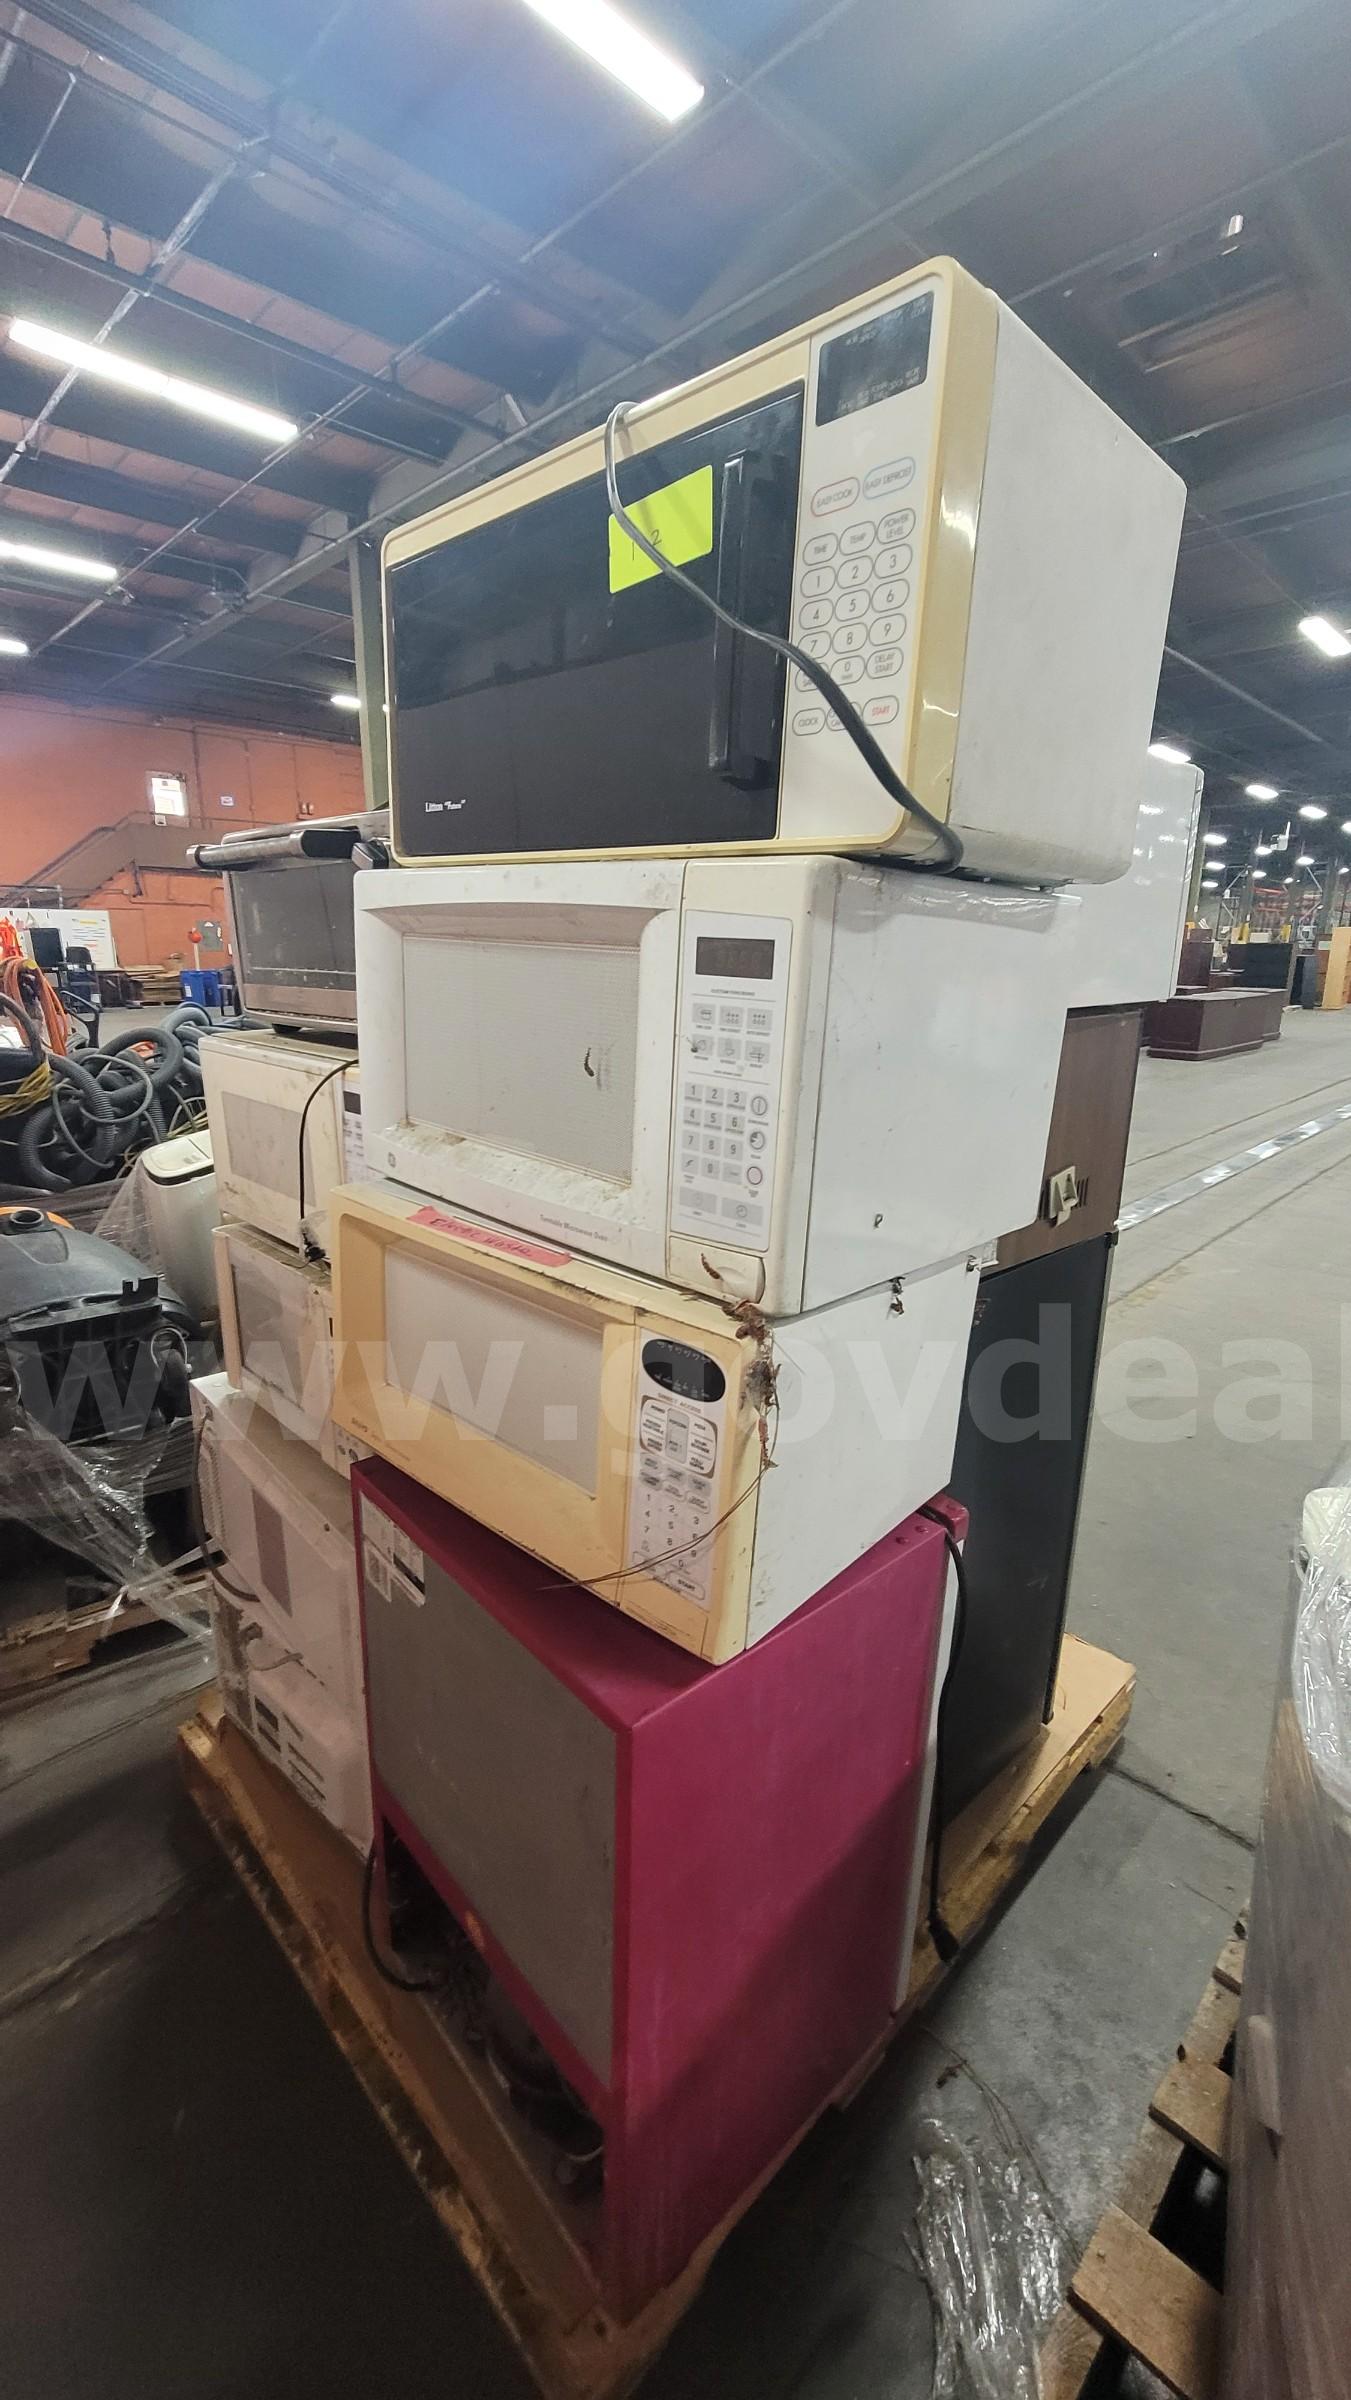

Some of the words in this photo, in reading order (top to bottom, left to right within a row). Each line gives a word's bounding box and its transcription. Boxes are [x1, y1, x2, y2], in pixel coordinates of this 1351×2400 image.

[833, 488, 854, 502] COOK
[883, 513, 910, 529] POWER
[886, 526, 905, 539] LEVEL
[889, 554, 898, 568] 3
[851, 566, 859, 580] 2
[886, 589, 895, 603] 6
[849, 598, 857, 612] 5
[813, 608, 820, 620] 4
[884, 623, 892, 636] 9
[846, 631, 854, 645] 8
[810, 639, 818, 653] 7
[874, 653, 896, 664] DELAY
[844, 661, 852, 672] 0
[874, 662, 895, 674] START
[871, 706, 891, 718] START
